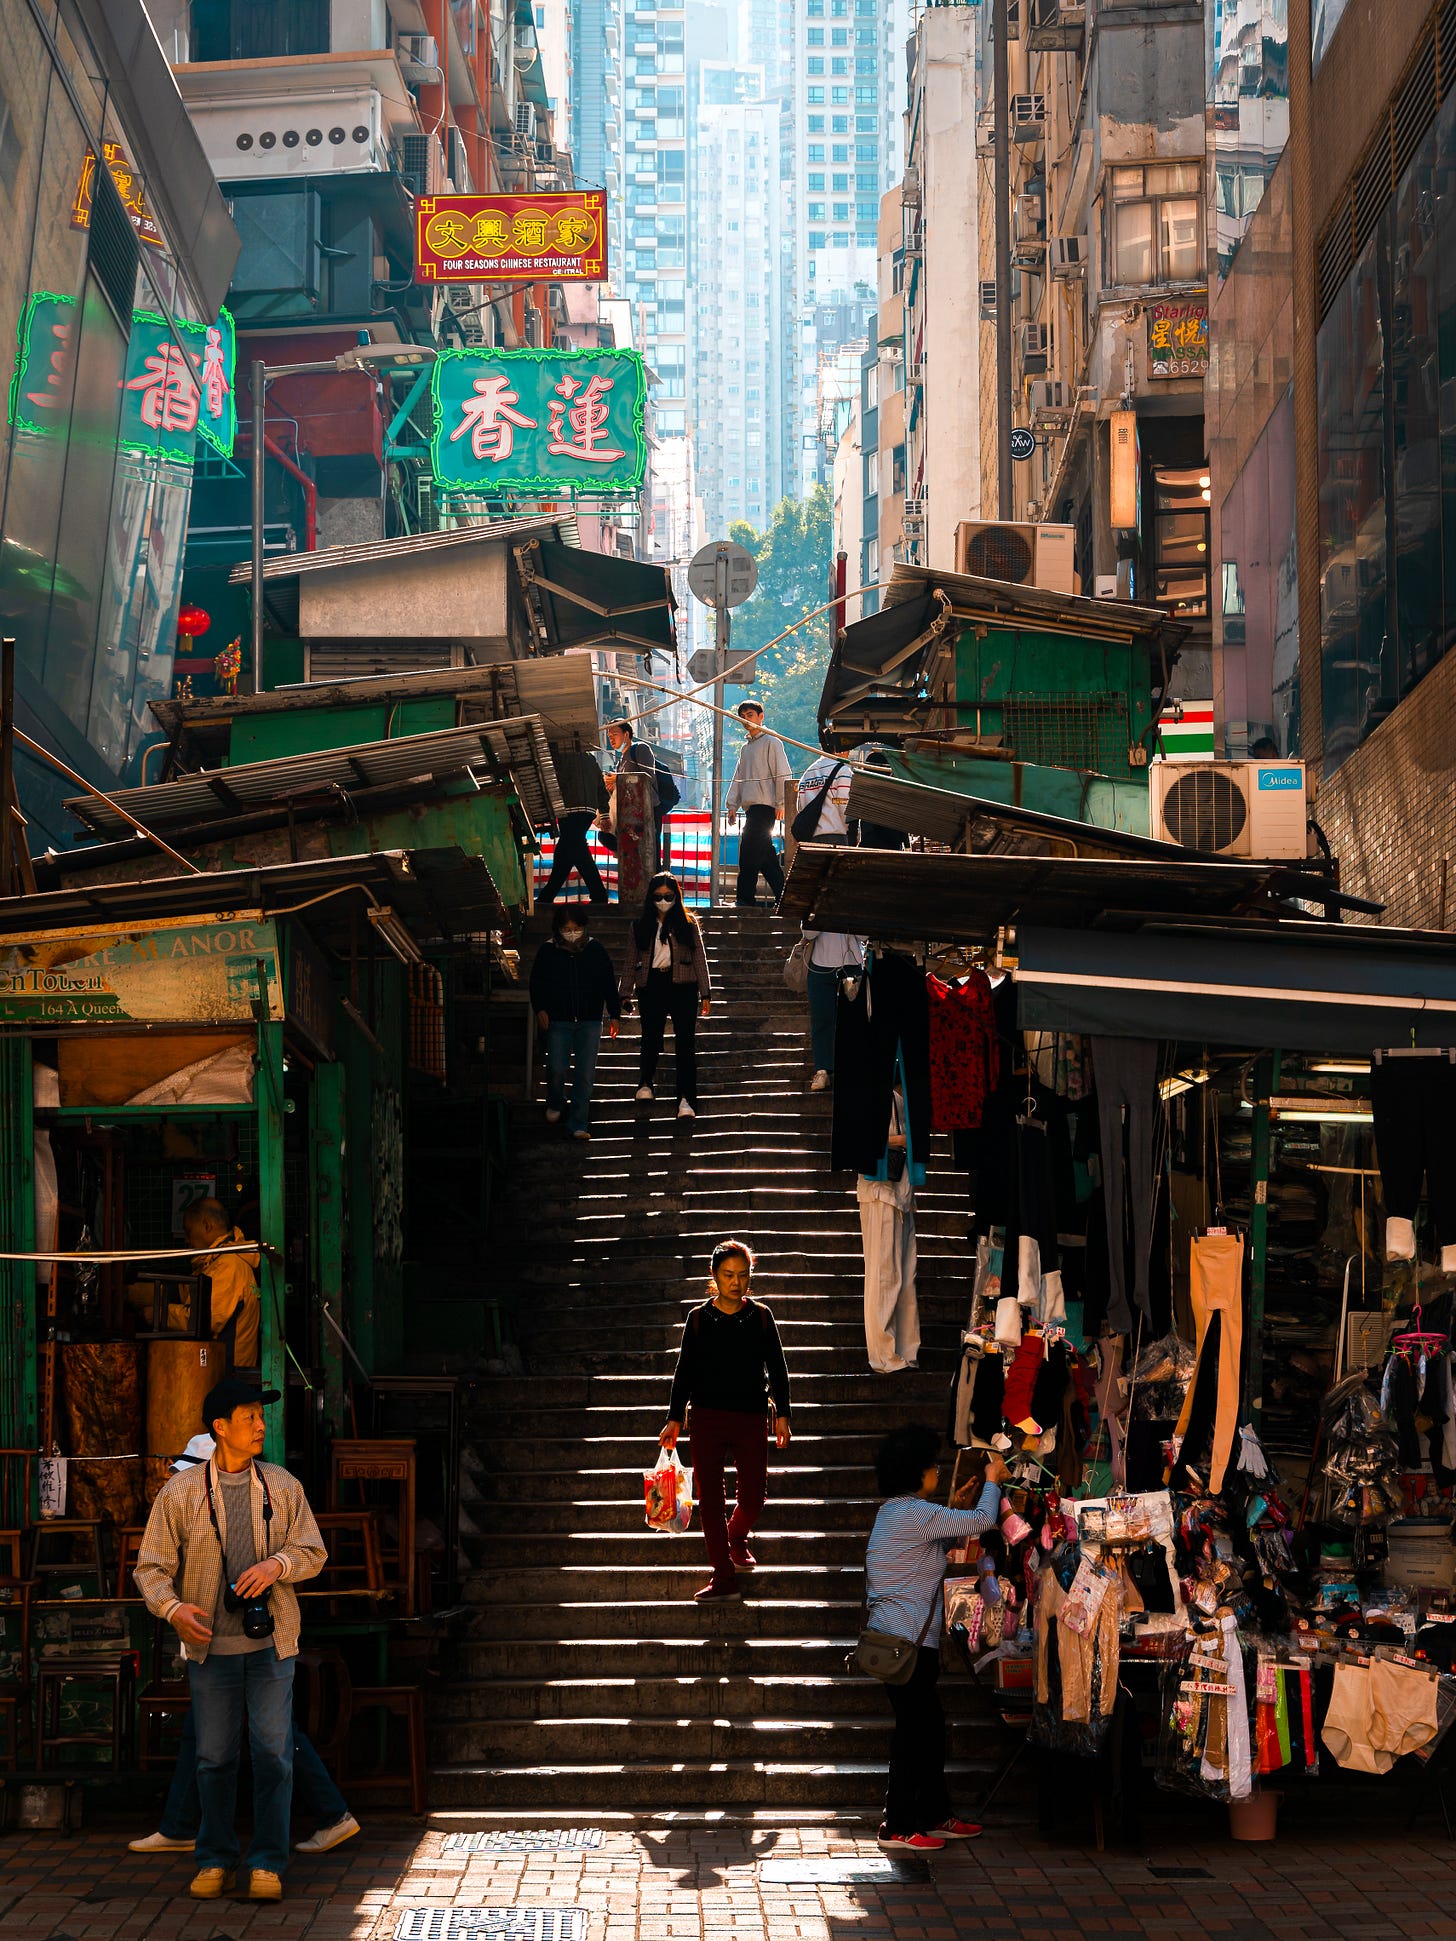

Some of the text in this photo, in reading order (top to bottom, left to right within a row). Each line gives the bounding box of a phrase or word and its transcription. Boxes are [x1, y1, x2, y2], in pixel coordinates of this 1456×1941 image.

[433, 218, 590, 250] 文興酒家
[443, 260, 463, 270] FOUR
[464, 259, 499, 270] SEASONS
[533, 256, 582, 268] RESTAURANT
[1267, 773, 1298, 786] Midea
